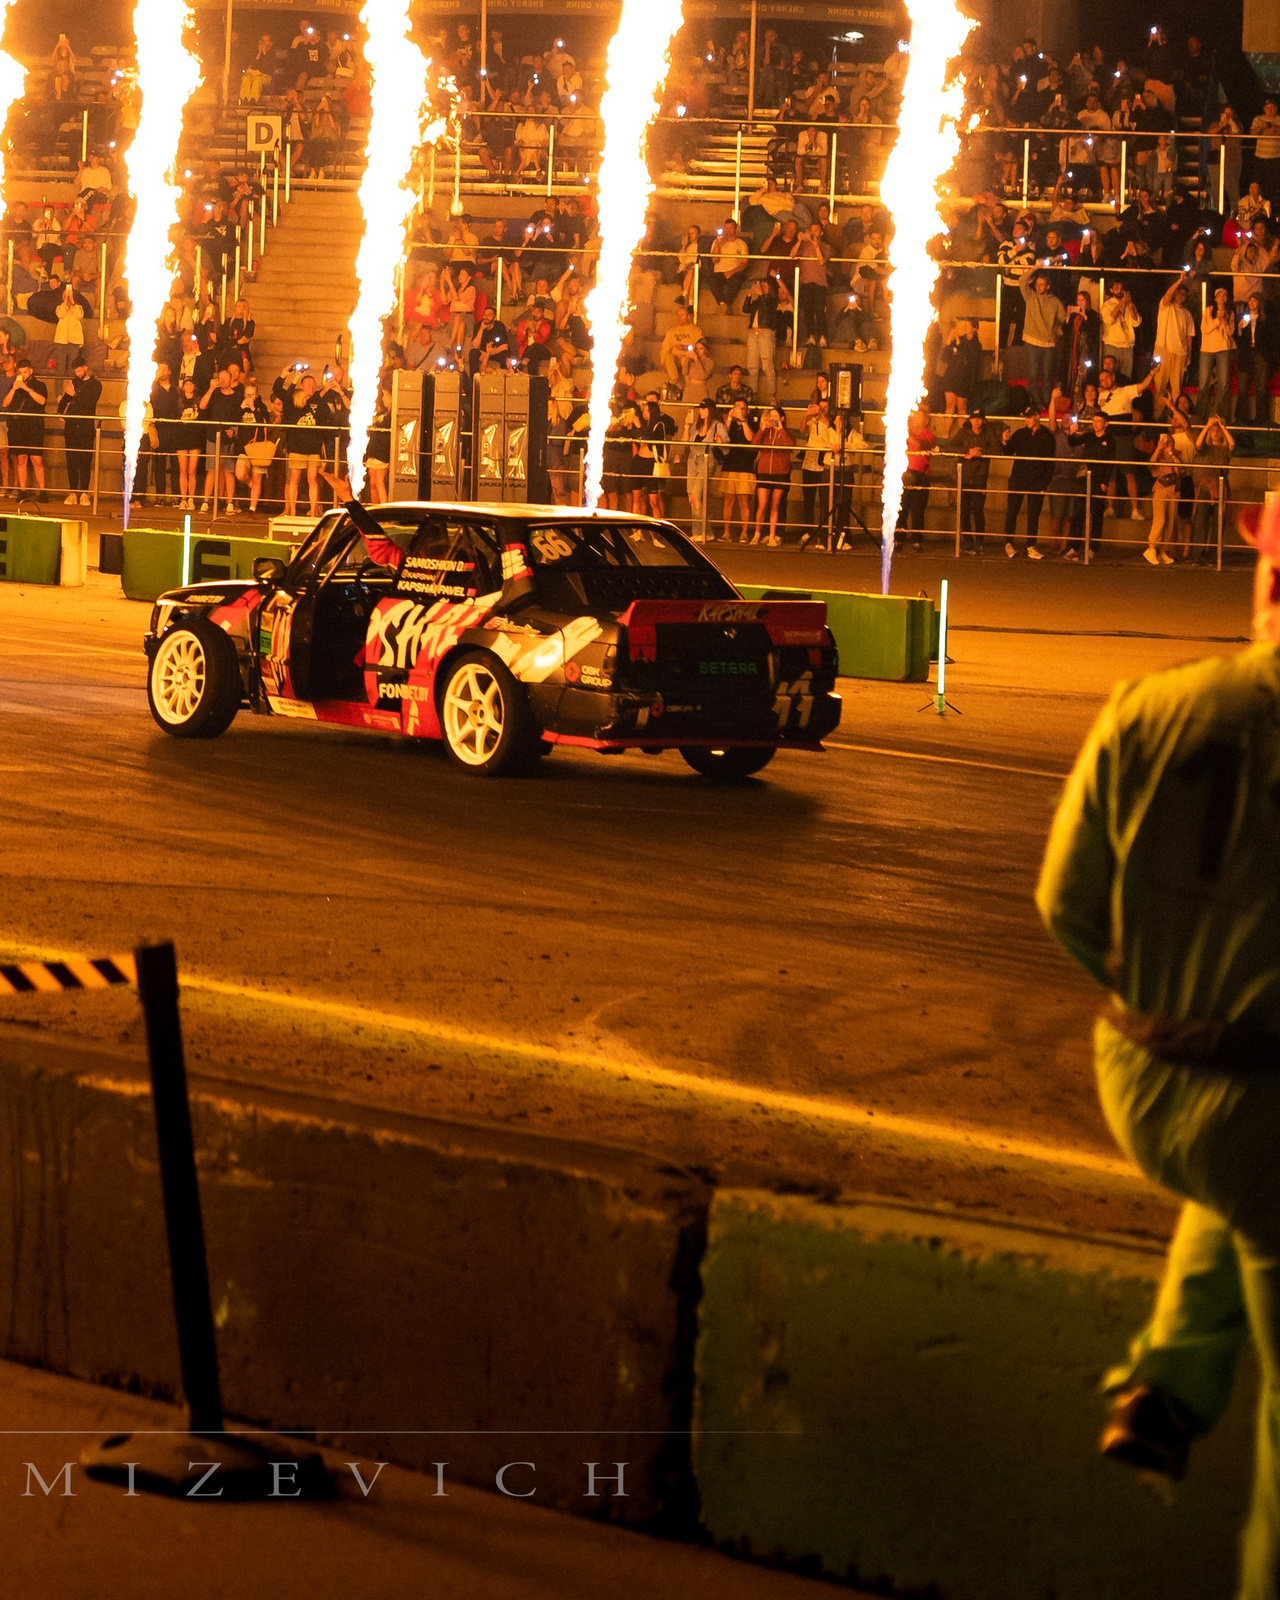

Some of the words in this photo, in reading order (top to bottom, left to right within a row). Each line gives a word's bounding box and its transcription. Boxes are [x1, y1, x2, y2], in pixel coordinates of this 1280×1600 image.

[255, 122, 274, 144] D
[533, 532, 572, 560] 66
[437, 584, 466, 597] PAVEL
[580, 674, 613, 688] GROUP
[378, 682, 429, 703] FONBET.BY
